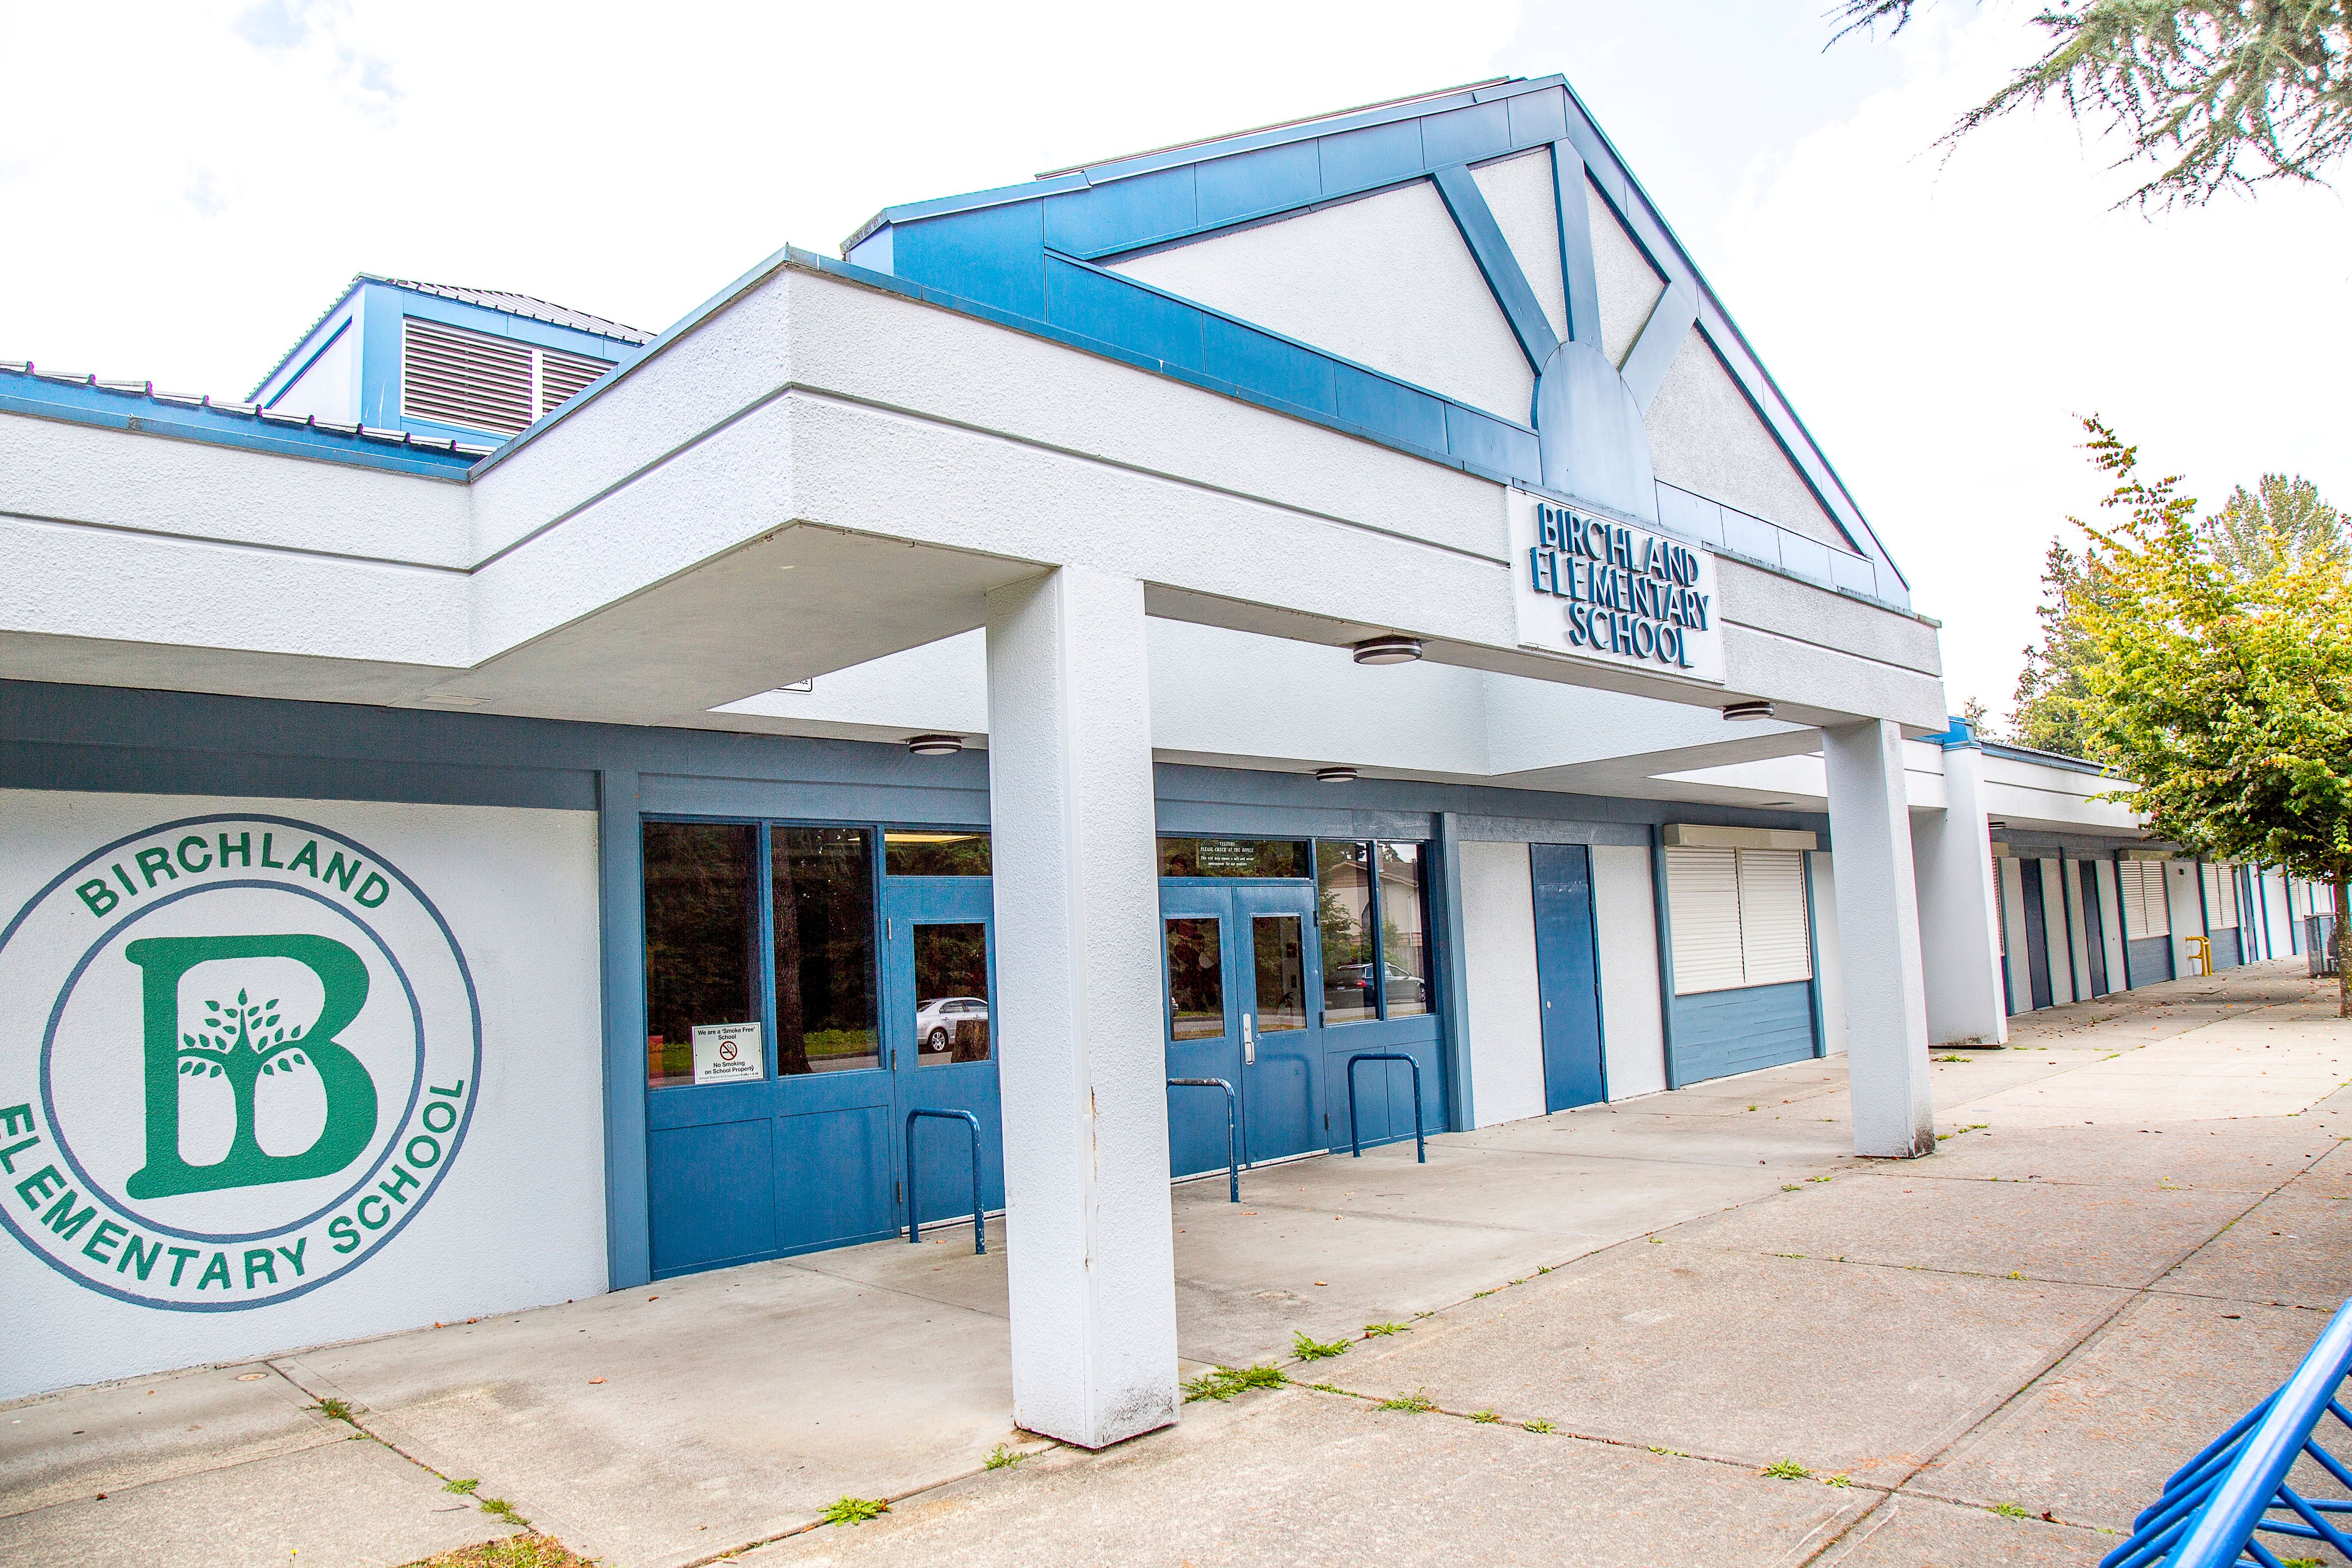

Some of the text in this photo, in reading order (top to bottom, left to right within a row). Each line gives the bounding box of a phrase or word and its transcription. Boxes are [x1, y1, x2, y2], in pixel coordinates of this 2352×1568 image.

[1538, 503, 1700, 588] BIRCHLAND
[1530, 546, 1711, 631] ELEMENTARY
[1568, 602, 1695, 668] SCHOOL
[76, 832, 391, 918] BIRCHLAND
[328, 1079, 464, 1253] SCHOOL
